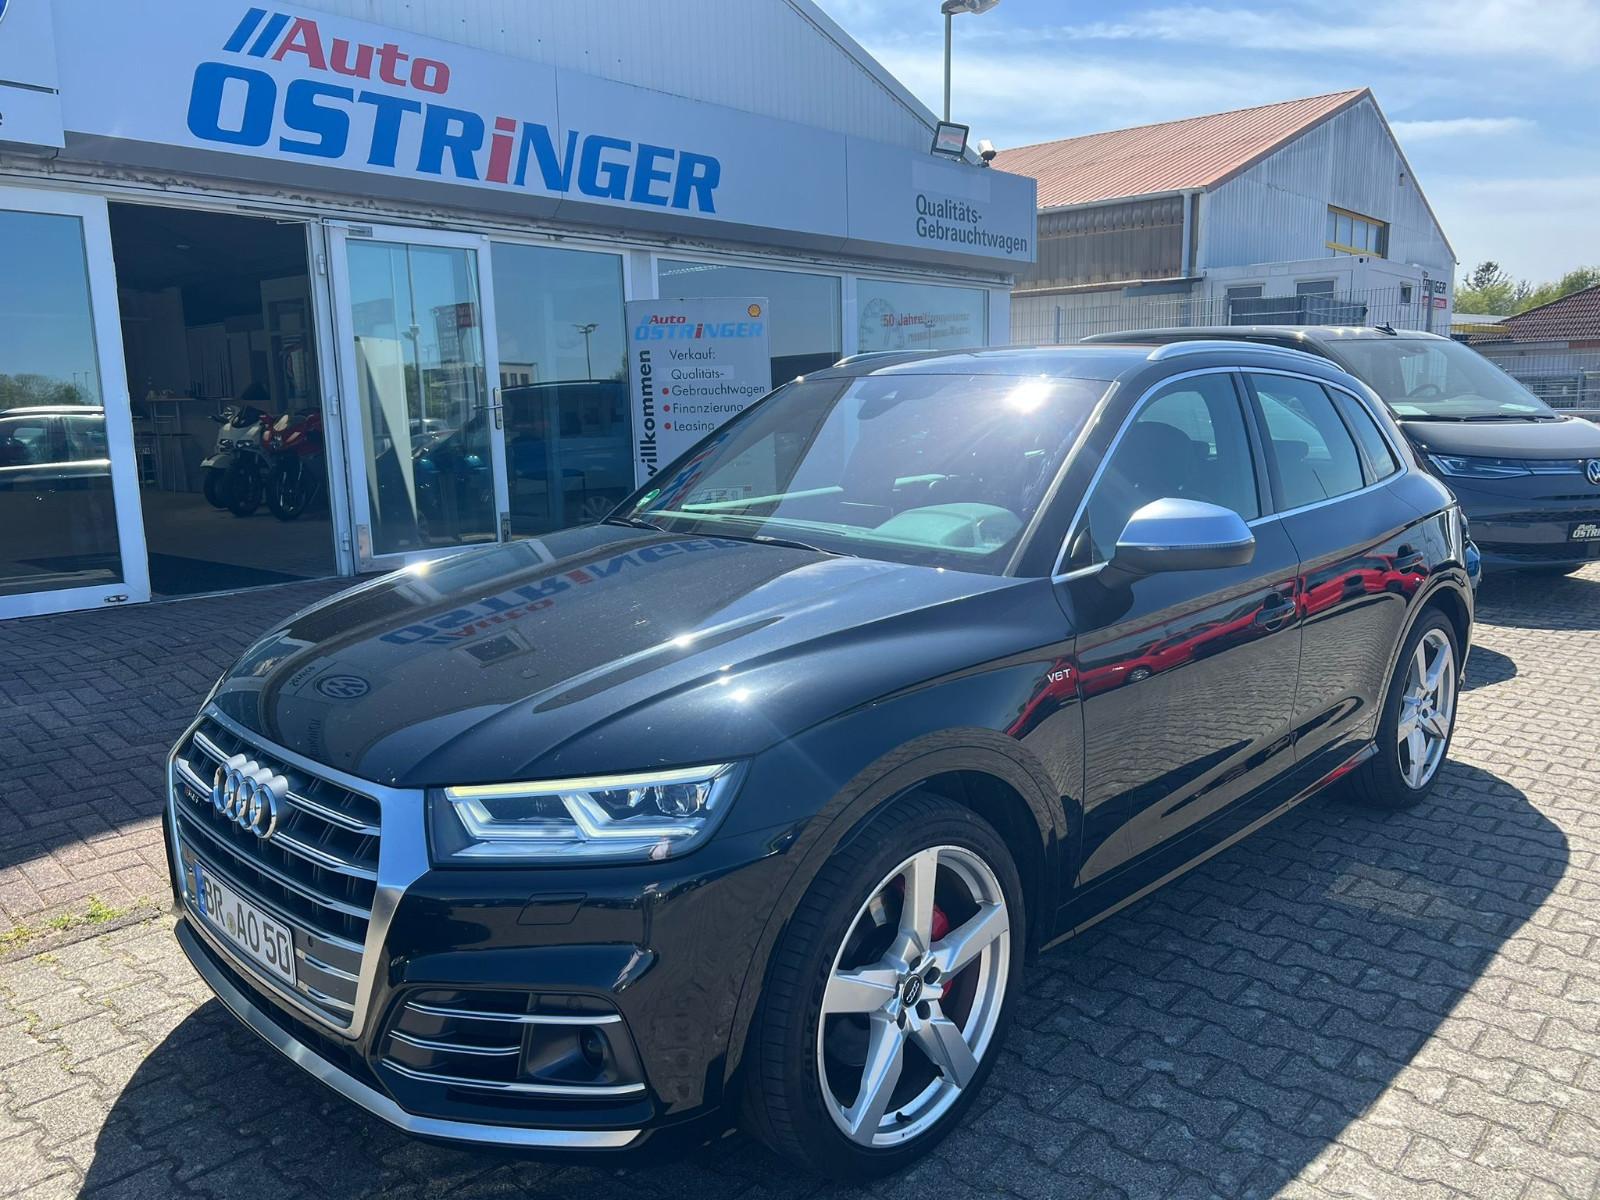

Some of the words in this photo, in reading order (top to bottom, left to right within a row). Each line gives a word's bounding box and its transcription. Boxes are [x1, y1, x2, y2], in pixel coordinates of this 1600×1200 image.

[271, 17, 450, 95] Auto
[916, 194, 982, 223] Qualitäts-
[916, 217, 1027, 254] Gebrauchtwagen
[648, 315, 686, 325] Auto
[883, 314, 894, 327] 50
[669, 348, 716, 360] Verkauf:
[671, 367, 724, 380] Qualitäts-
[671, 384, 765, 397] Gebrauchtwagen
[1047, 669, 1071, 683] V6T
[203, 875, 226, 927] BR
[236, 902, 260, 953] AO
[262, 920, 291, 976] 50
